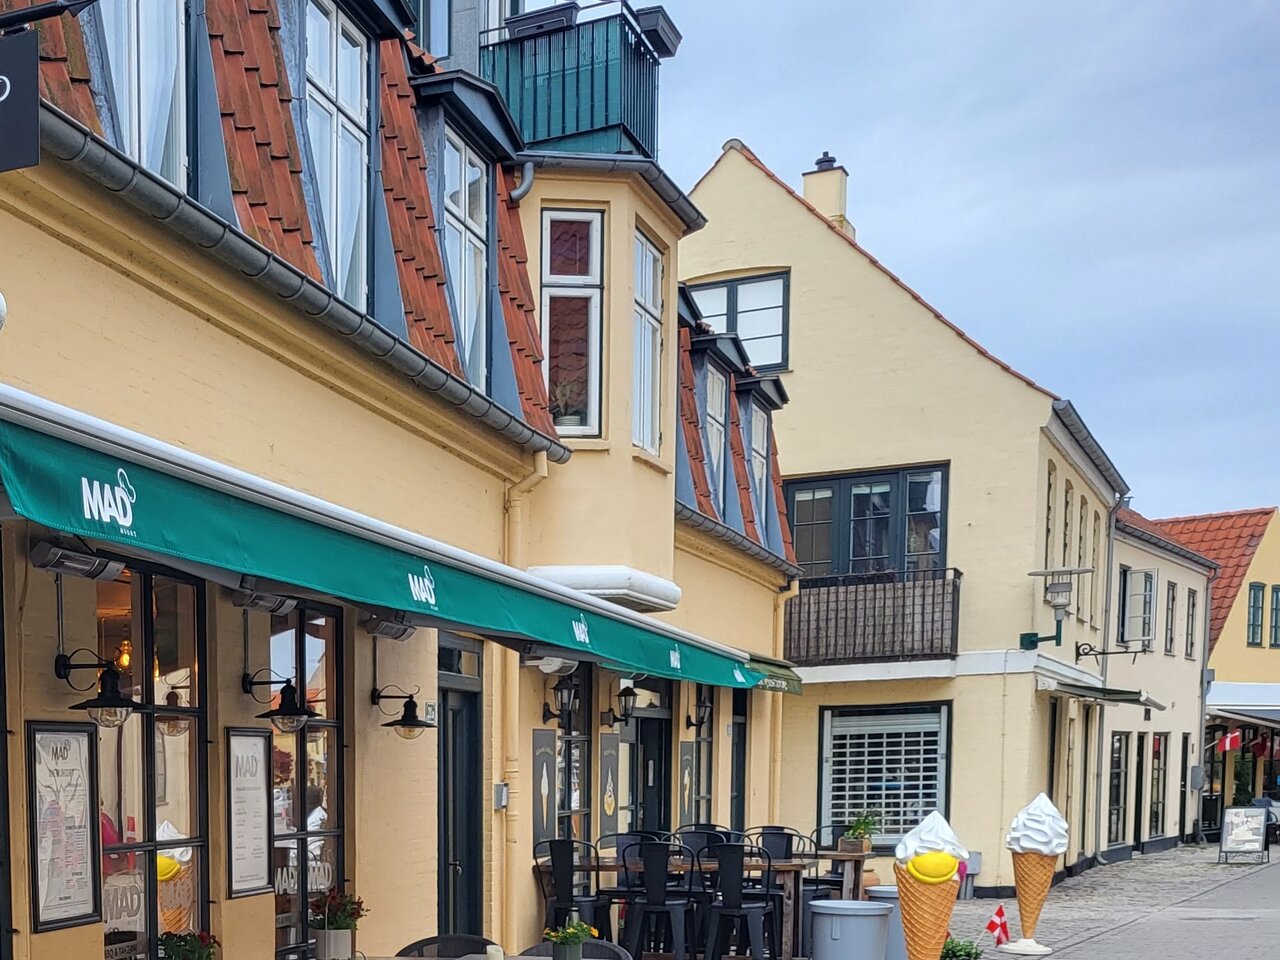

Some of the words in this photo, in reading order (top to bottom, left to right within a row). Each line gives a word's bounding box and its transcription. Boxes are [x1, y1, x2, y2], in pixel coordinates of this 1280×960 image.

[81, 476, 133, 527] MAD
[407, 573, 436, 605] MAD
[51, 745, 69, 761] MAD
[235, 754, 259, 779] MAD
[104, 886, 141, 921] MAD
